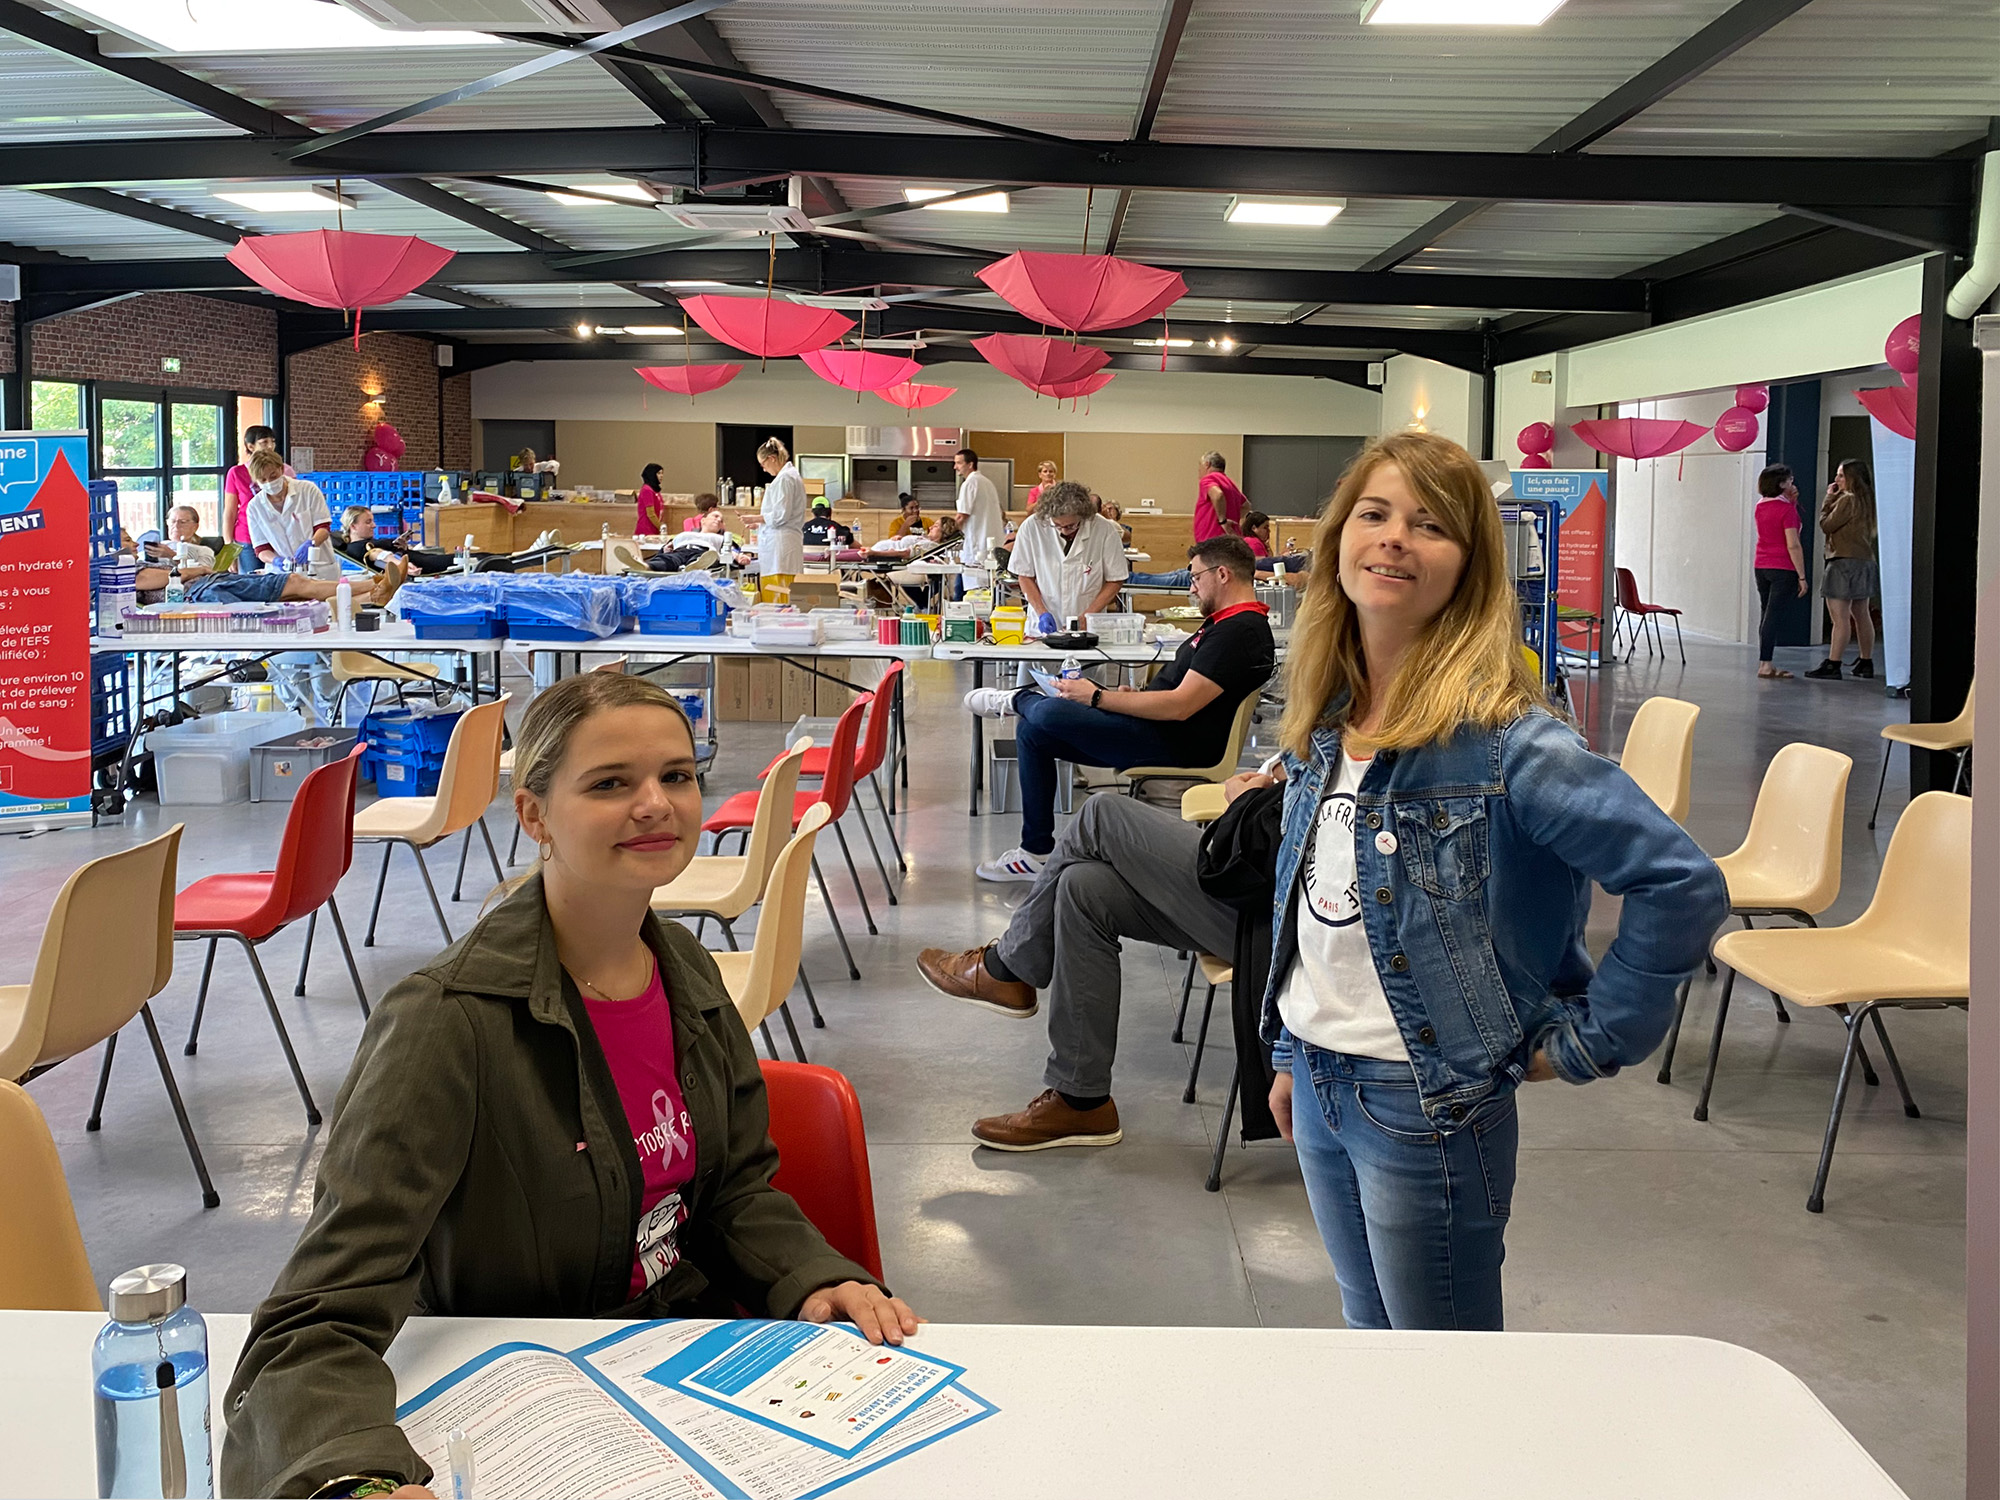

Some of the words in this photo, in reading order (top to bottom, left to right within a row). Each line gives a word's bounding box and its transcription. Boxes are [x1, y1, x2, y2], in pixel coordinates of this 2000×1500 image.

[0, 513, 40, 533] ENT
[18, 560, 63, 572] hydraté
[66, 560, 74, 568] ?
[12, 587, 19, 596] à
[23, 587, 50, 596] vous
[33, 624, 52, 634] par
[2, 638, 17, 647] de
[0, 649, 39, 660] lifié(e)
[24, 673, 67, 684] environ
[71, 672, 84, 681] 10
[10, 688, 25, 697] de
[29, 685, 77, 698] prélever
[2, 701, 16, 710] ml
[20, 700, 35, 709] de
[39, 699, 67, 710] sang
[17, 726, 39, 738] peu
[1318, 897, 1338, 912] PARIS
[680, 1111, 692, 1135] R
[898, 1373, 919, 1386] QU'IL
[913, 1376, 930, 1387] DON
[882, 1386, 901, 1399] FAUT
[885, 1394, 905, 1408] SANG
[852, 1421, 868, 1431] FER
